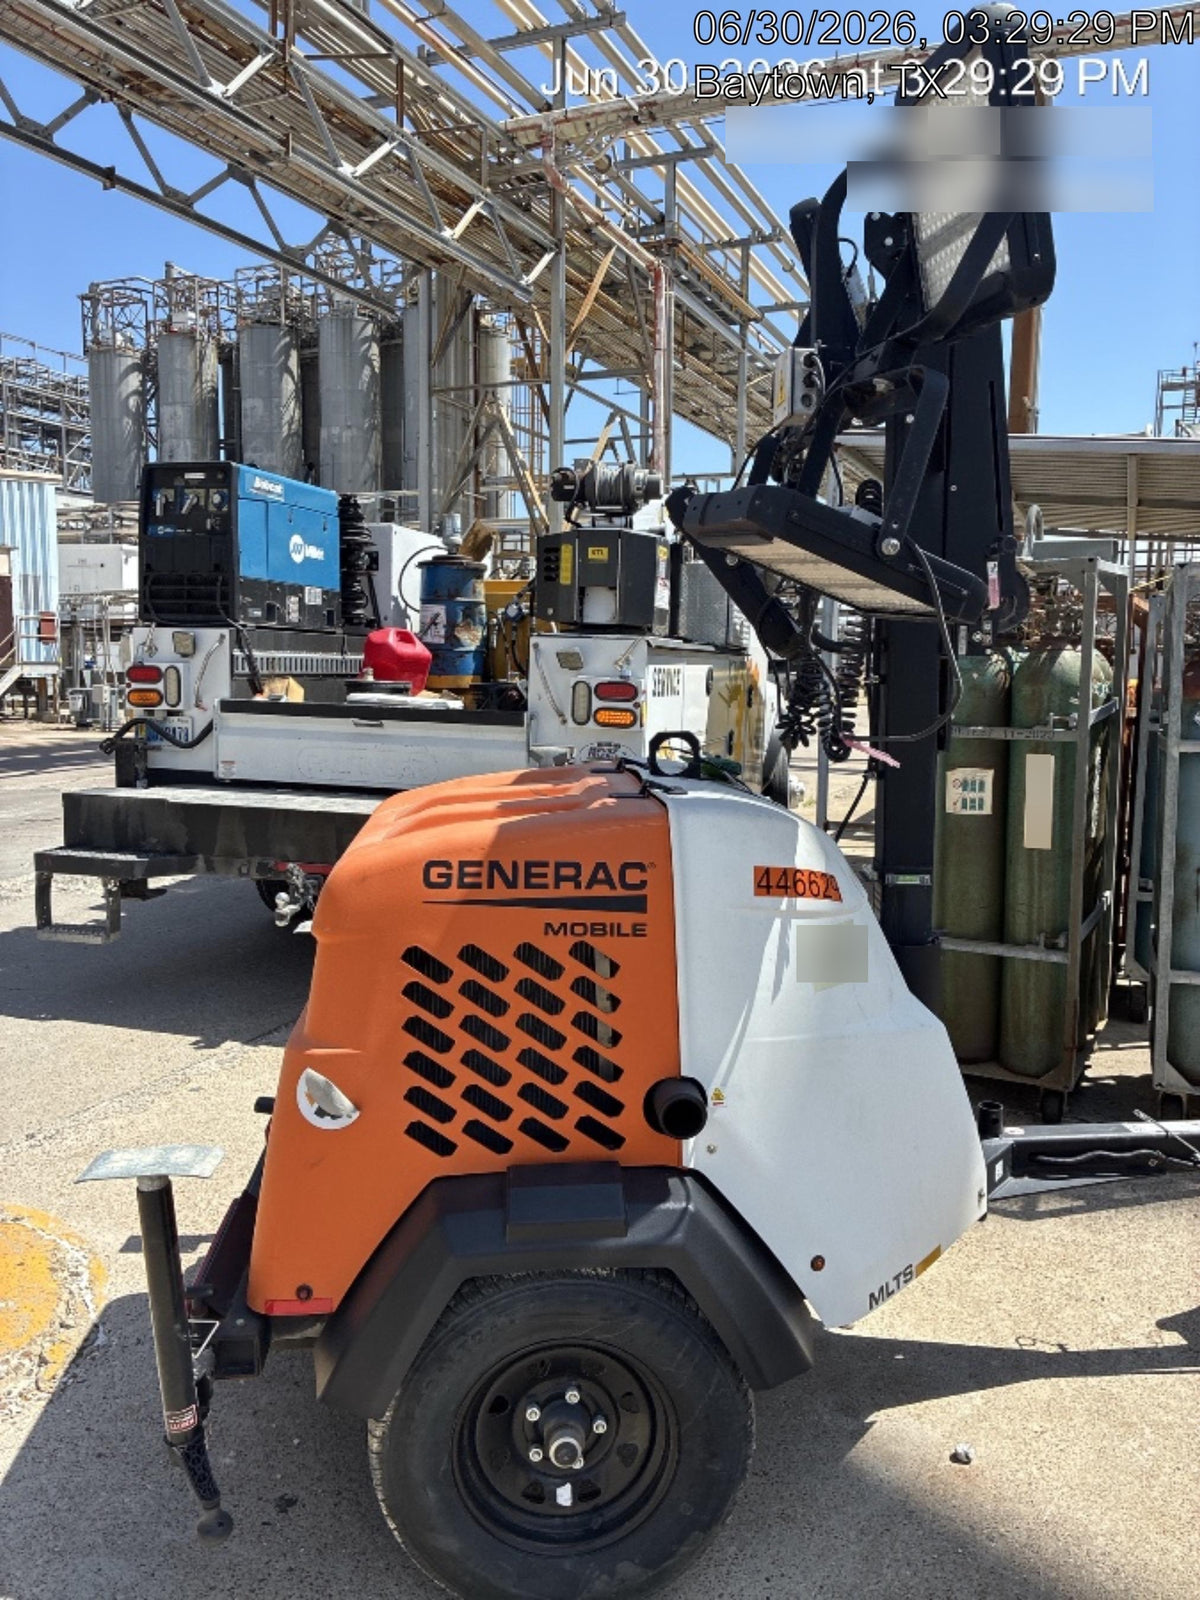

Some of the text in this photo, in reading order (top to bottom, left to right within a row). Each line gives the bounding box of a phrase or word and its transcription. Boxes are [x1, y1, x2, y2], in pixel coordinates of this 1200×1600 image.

[422, 860, 648, 891] GENERAC
[543, 922, 648, 937] MOBILE
[868, 1263, 913, 1312] MLTS
